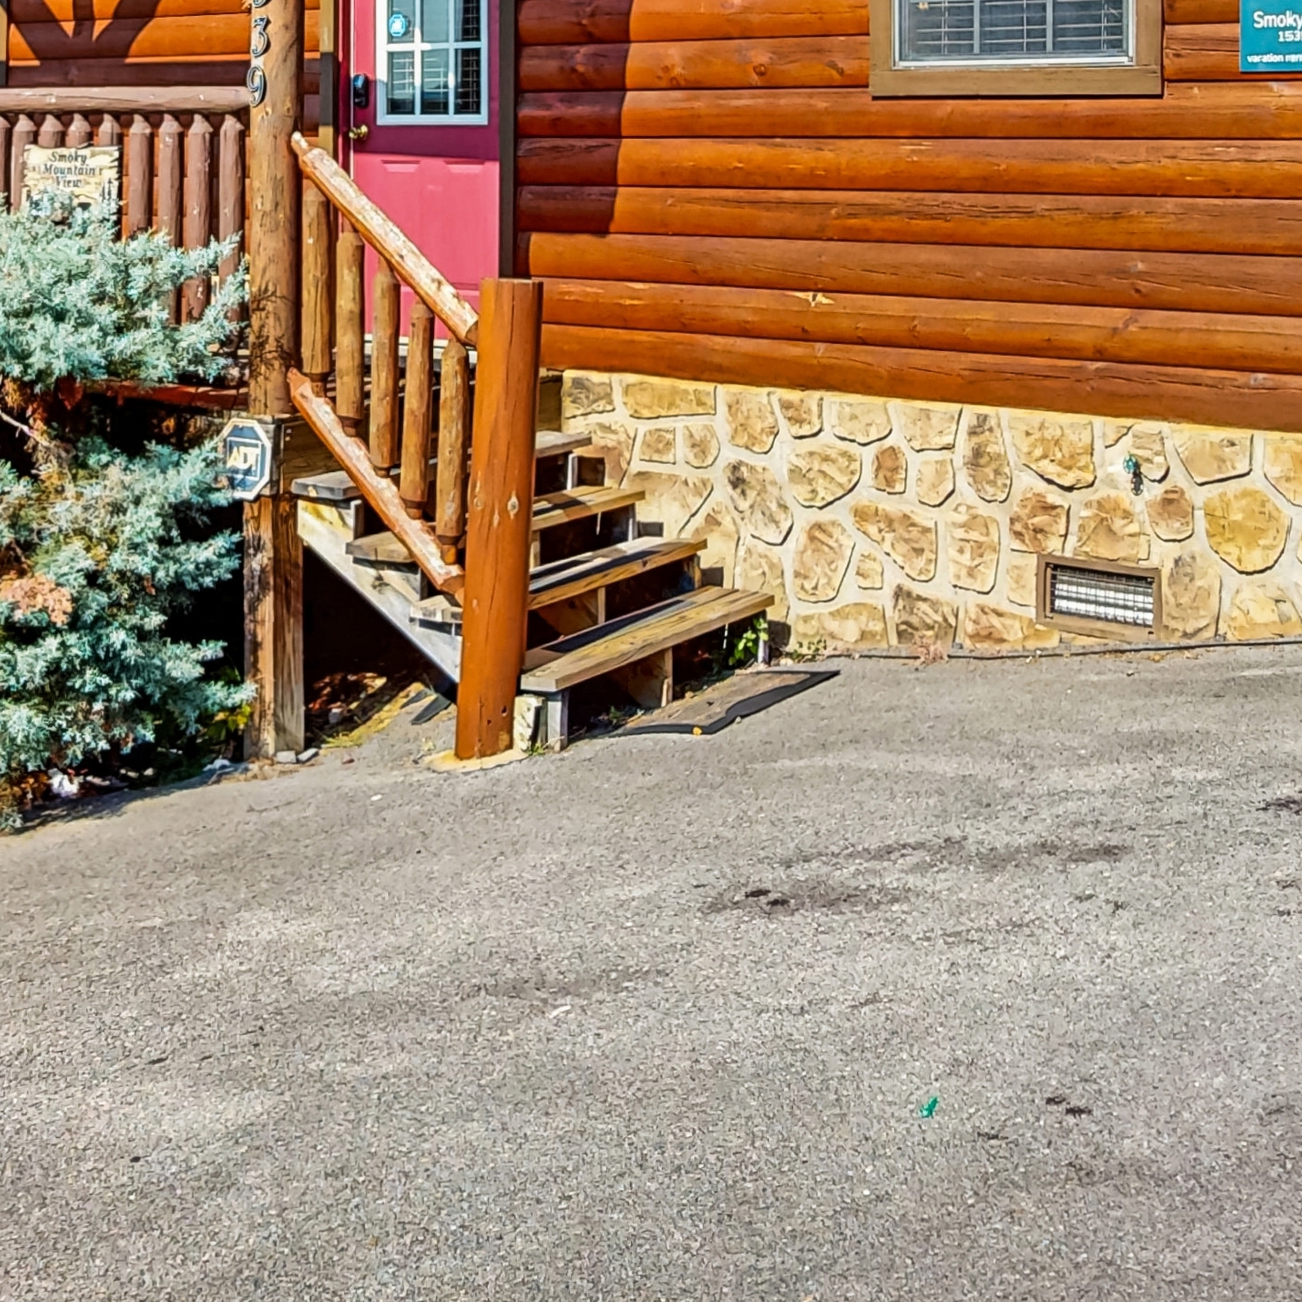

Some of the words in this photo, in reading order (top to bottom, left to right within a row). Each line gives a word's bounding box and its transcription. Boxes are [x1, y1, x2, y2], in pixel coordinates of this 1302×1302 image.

[1247, 53, 1284, 64] vacation
[50, 151, 88, 167] Smoky
[42, 163, 96, 176] Mountain
